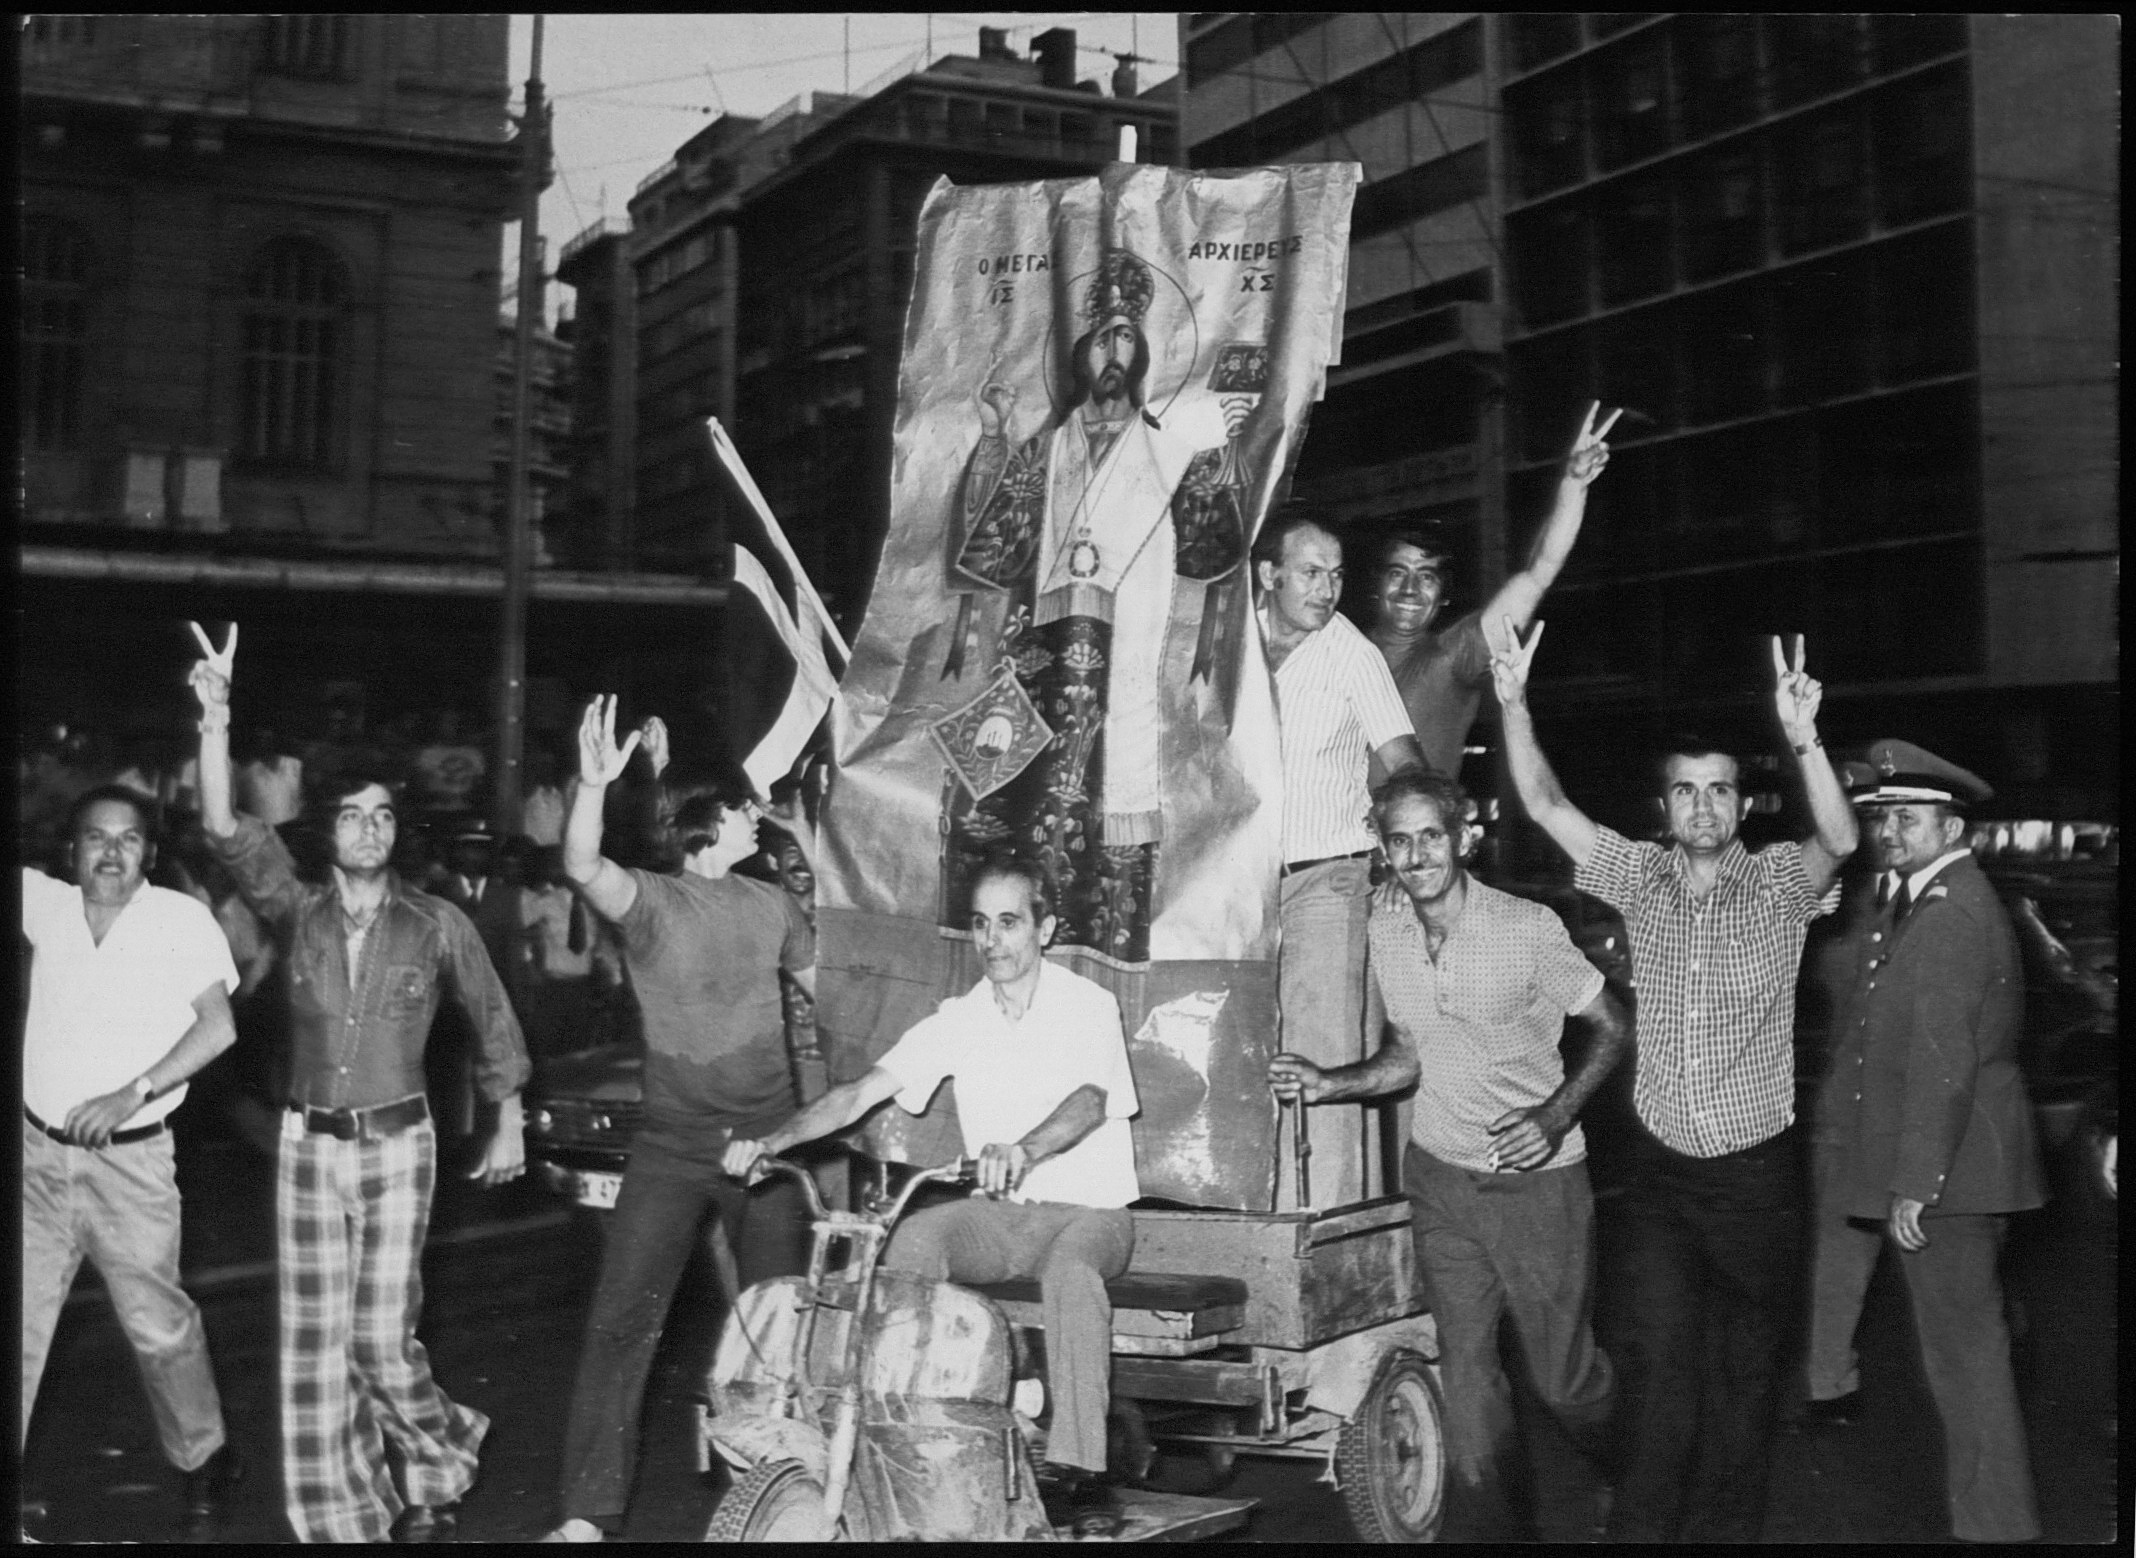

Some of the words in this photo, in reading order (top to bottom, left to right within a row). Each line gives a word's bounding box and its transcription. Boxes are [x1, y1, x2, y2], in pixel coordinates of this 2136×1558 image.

[978, 258, 989, 275] Ο
[1188, 235, 1303, 261] ΑΡΧΙΕΡΕΥΣ
[1240, 272, 1275, 293] ΧΣ
